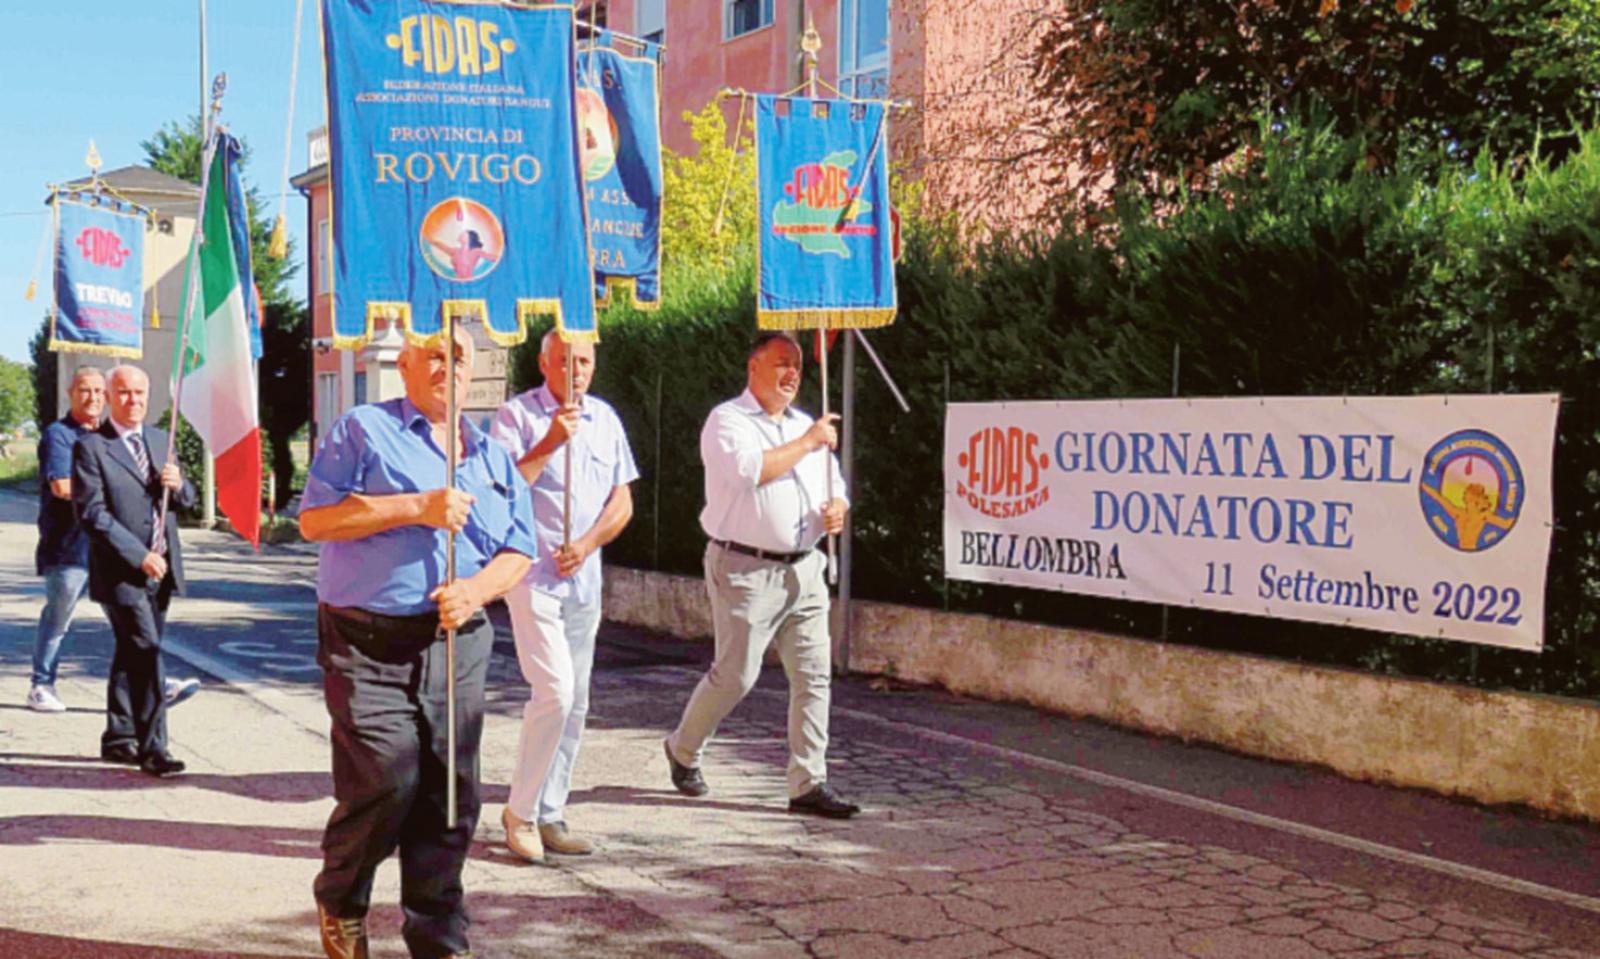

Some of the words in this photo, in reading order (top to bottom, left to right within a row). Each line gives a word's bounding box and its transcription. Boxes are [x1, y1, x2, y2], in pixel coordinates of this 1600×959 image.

[400, 14, 499, 75] FIDAS
[390, 126, 498, 143] PROVINCIA
[503, 129, 523, 143] DI
[374, 151, 542, 185] ROVIGO
[968, 426, 1040, 497] FIDAS
[1055, 431, 1288, 478] GIORNATA
[1298, 434, 1412, 483] DEL
[957, 480, 1049, 519] POLESANA
[1090, 490, 1354, 549] DONATORE
[960, 531, 1128, 580] BELLOMBRA
[1203, 561, 1234, 595] 11
[1258, 563, 1419, 613] Settembre
[1433, 581, 1523, 626] 2022
